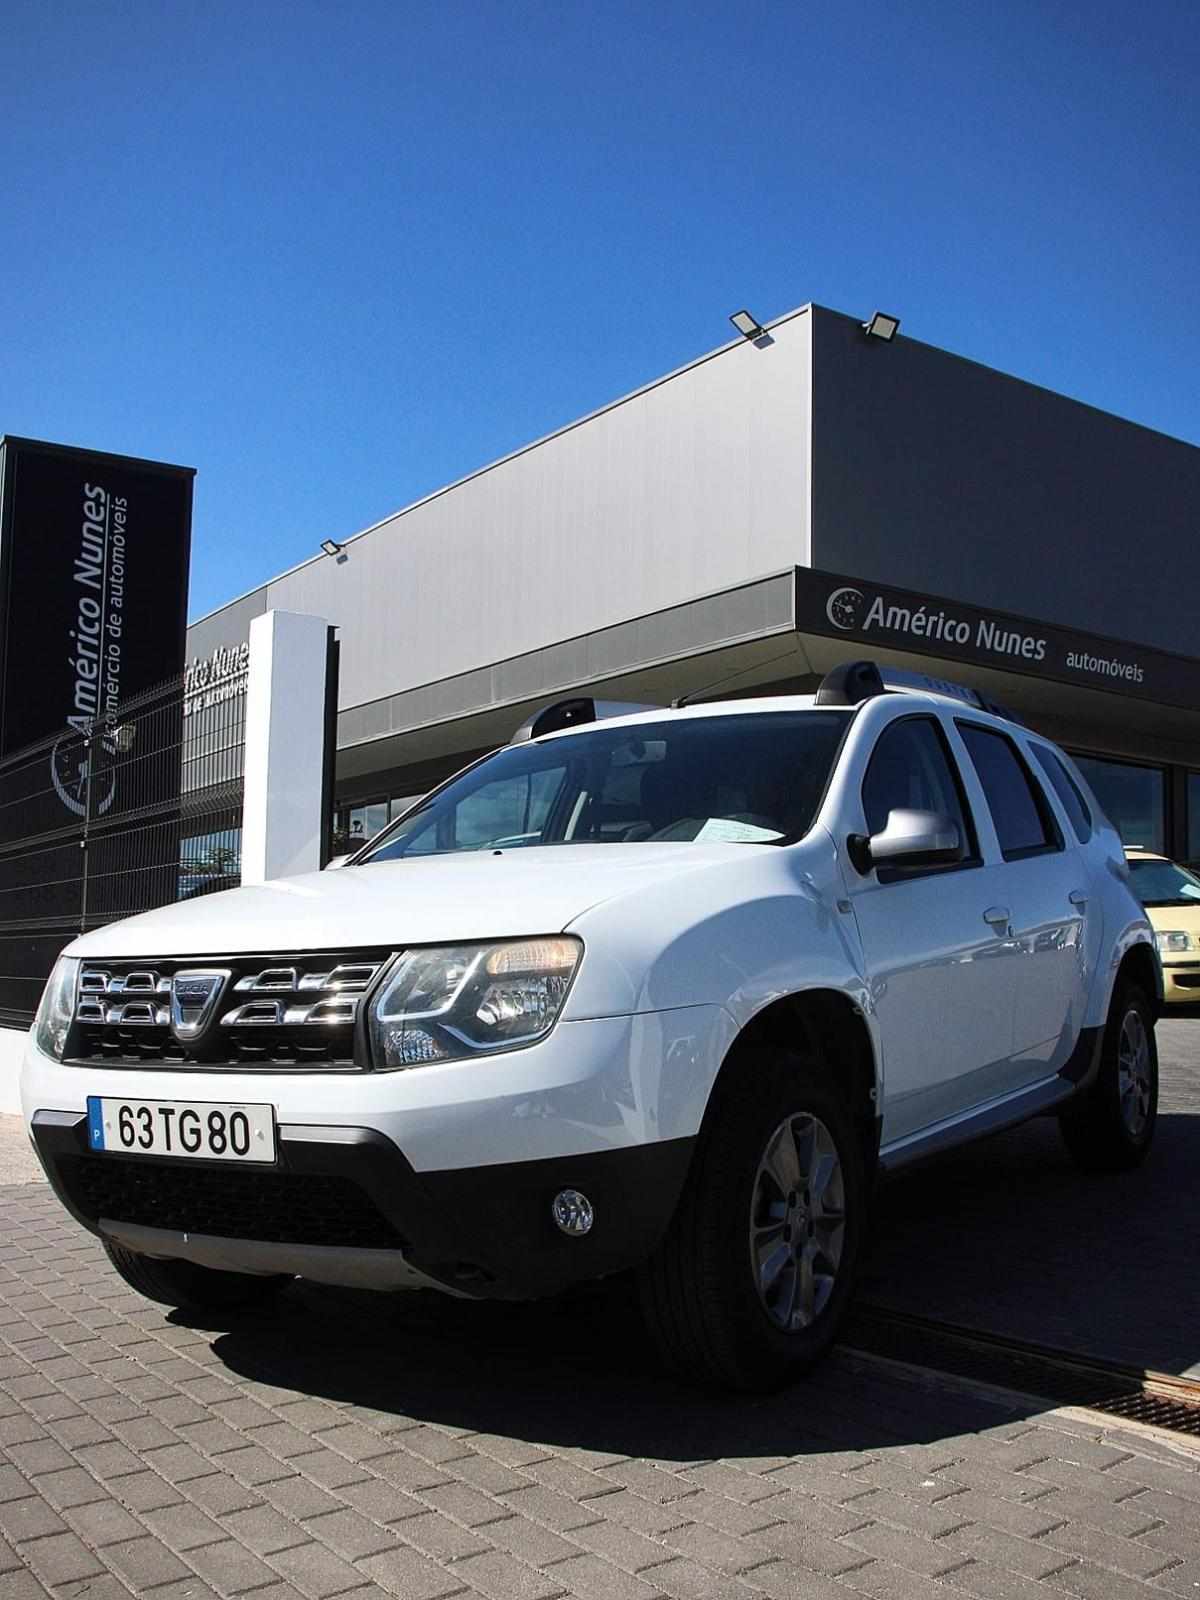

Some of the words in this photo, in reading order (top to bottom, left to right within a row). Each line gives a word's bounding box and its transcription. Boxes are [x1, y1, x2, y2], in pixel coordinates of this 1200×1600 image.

[73, 482, 106, 589] Nunes
[109, 496, 128, 608] automóveis
[67, 597, 101, 736] Américo
[106, 613, 122, 638] de
[211, 641, 249, 682] Nune
[861, 596, 970, 644] Américo
[975, 619, 1047, 661] Nunes
[1066, 651, 1144, 683] automóveis
[93, 1128, 101, 1140] P
